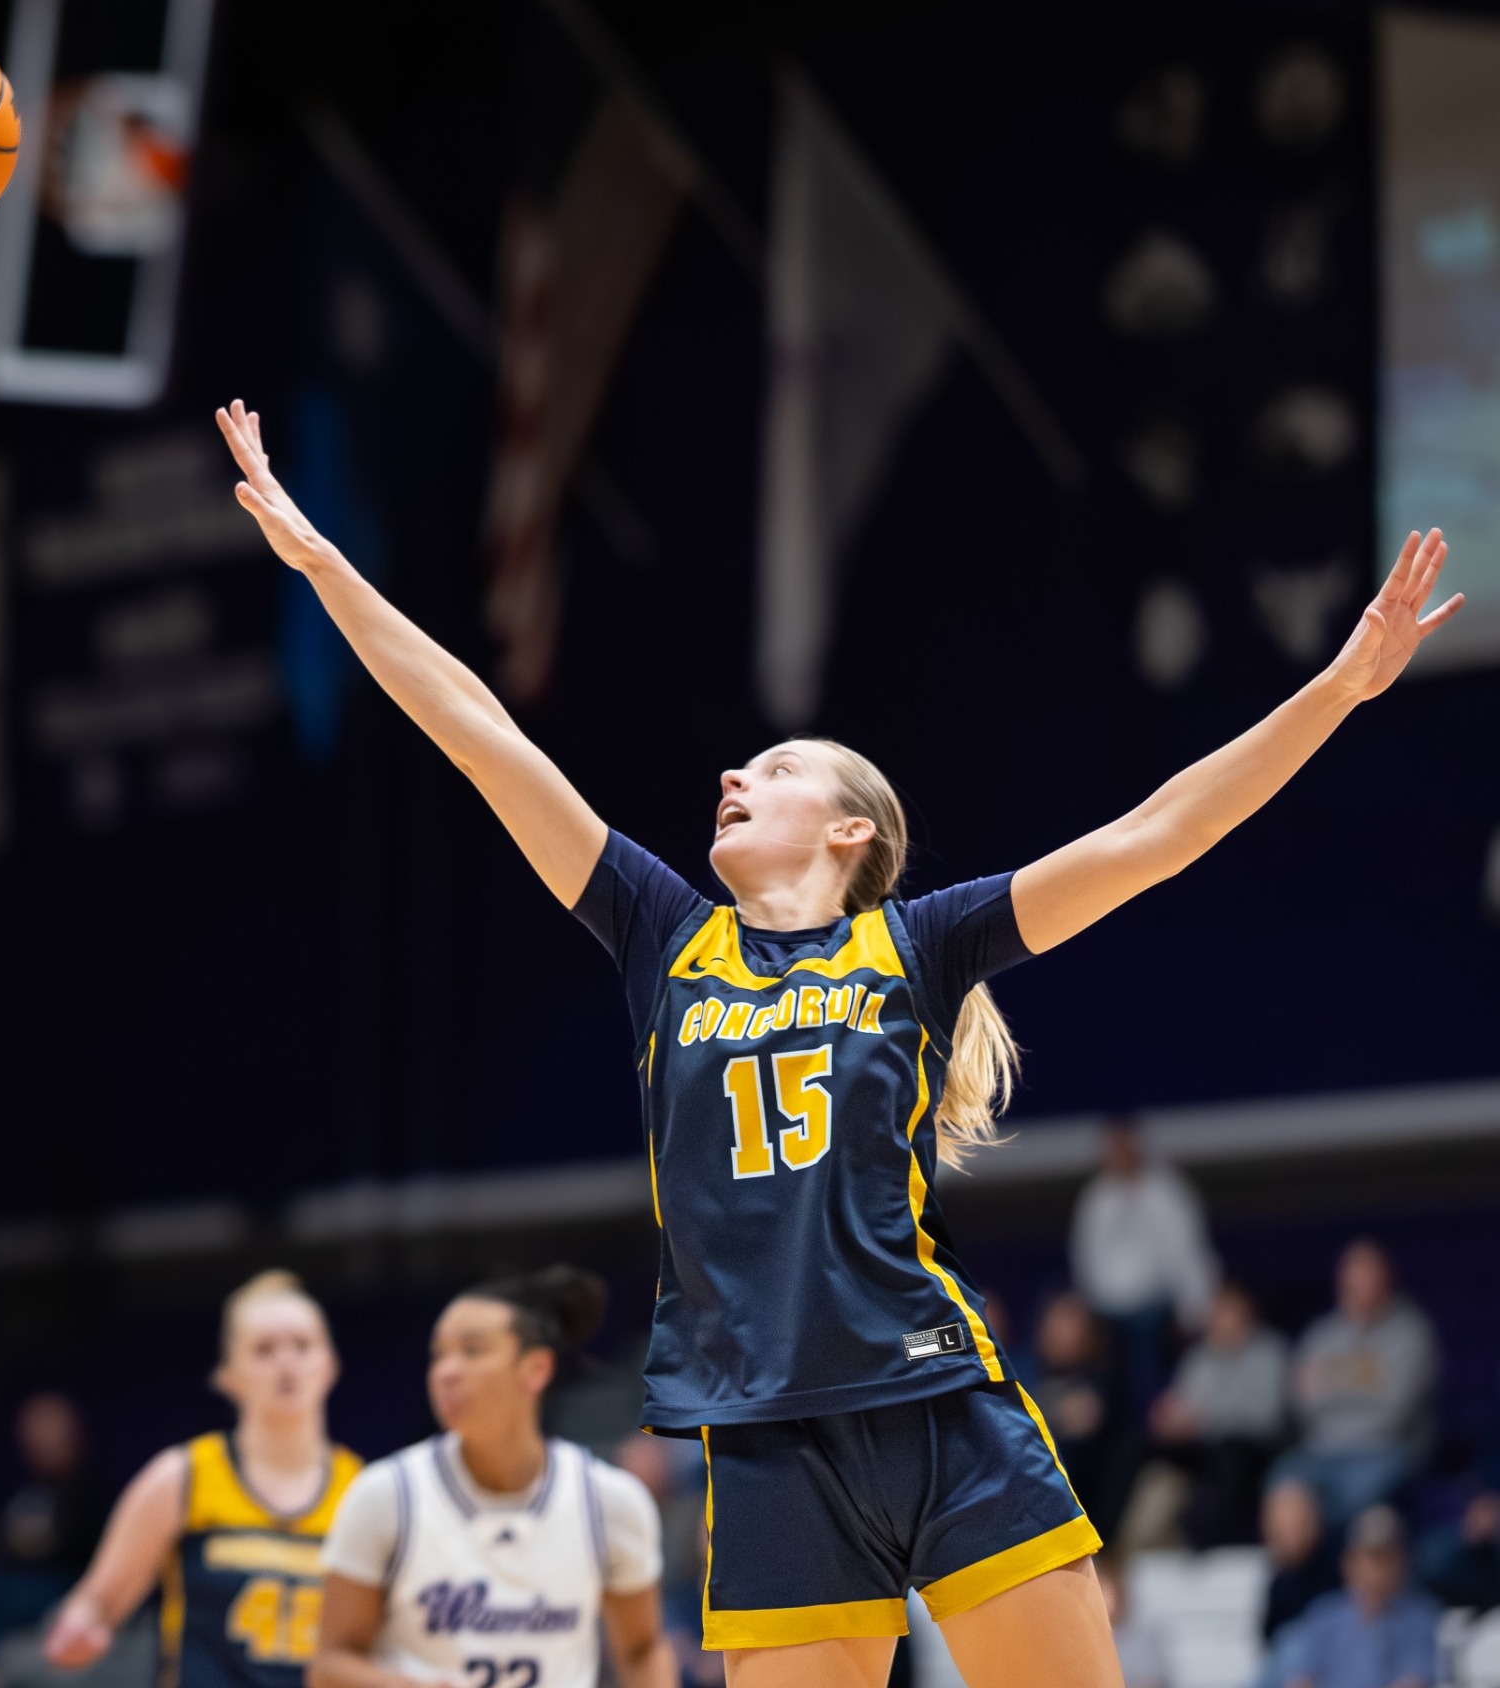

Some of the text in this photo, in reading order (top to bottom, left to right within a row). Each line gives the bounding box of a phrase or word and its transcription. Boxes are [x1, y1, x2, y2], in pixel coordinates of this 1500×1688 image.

[678, 983, 886, 1047] CONCORDIA
[723, 1043, 833, 1180] 15
[944, 1334, 955, 1346] L
